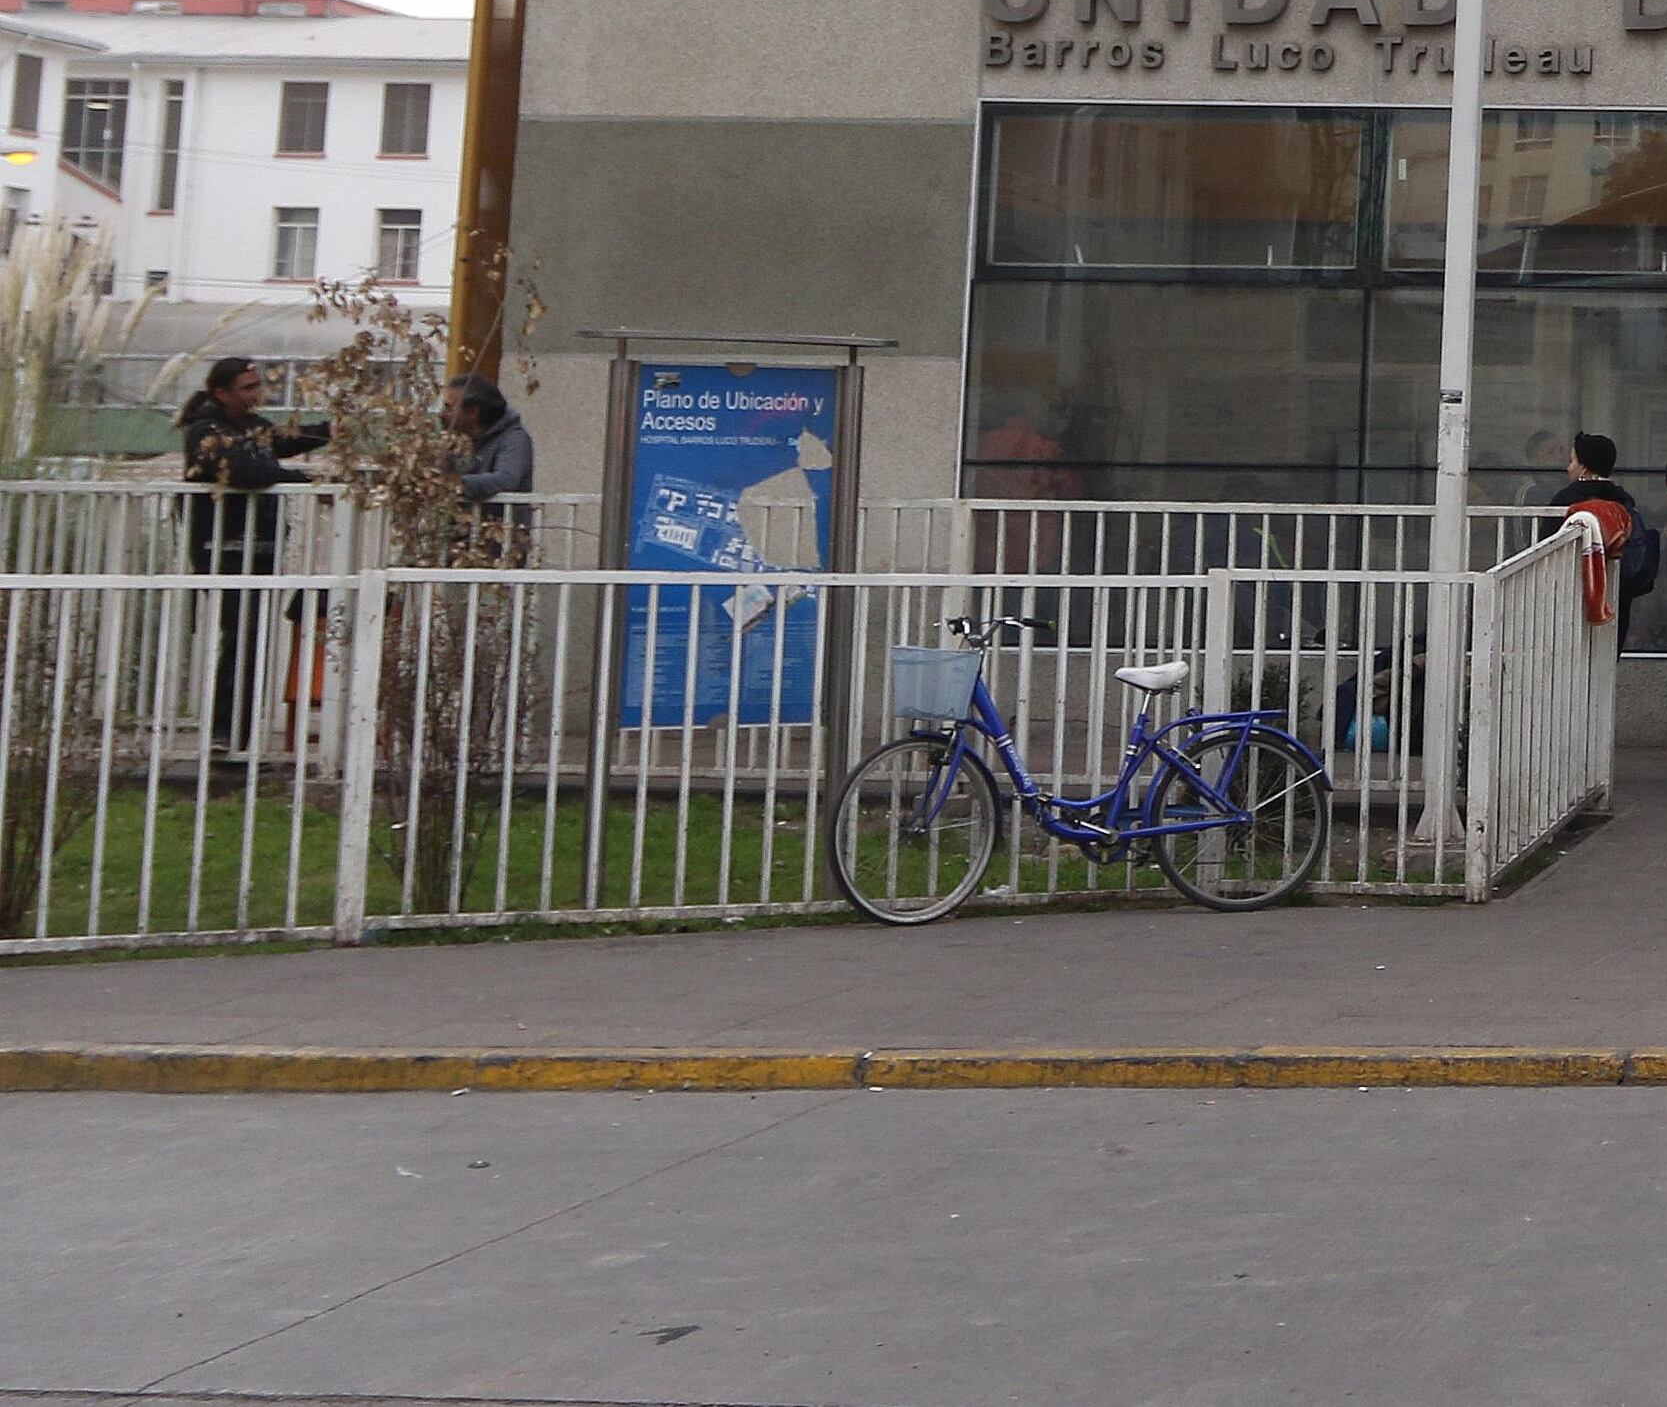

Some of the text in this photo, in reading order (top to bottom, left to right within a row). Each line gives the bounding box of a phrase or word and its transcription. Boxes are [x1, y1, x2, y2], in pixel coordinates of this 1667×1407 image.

[984, 30, 1166, 71] Barros
[1210, 33, 1336, 72] Luco
[642, 389, 824, 415] Plano de Ubicación y
[640, 411, 716, 431] Accesos
